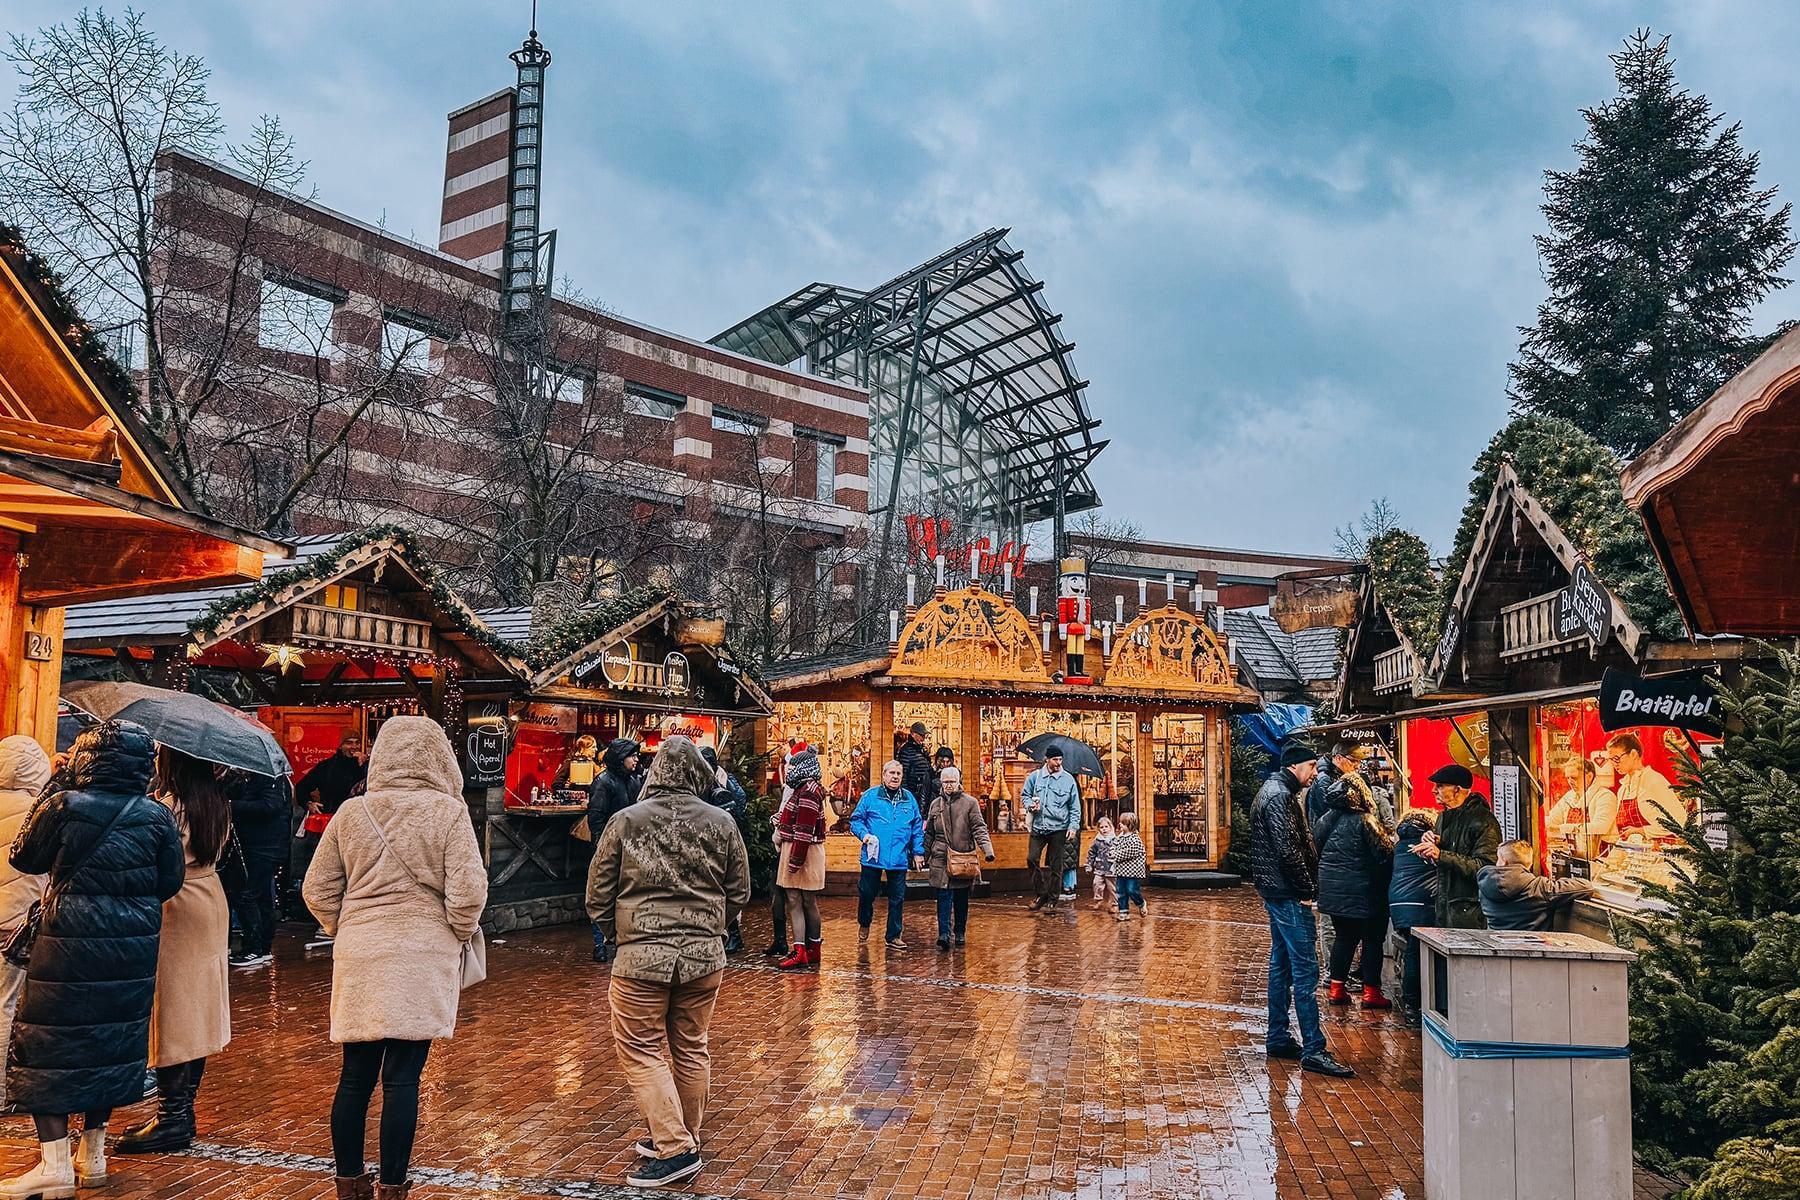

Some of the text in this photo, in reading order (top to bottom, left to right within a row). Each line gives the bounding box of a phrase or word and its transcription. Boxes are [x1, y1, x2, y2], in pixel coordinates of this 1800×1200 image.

[31, 635, 52, 657] 24
[1615, 689, 1713, 721] Bratäpfel
[1141, 723, 1152, 733] 26
